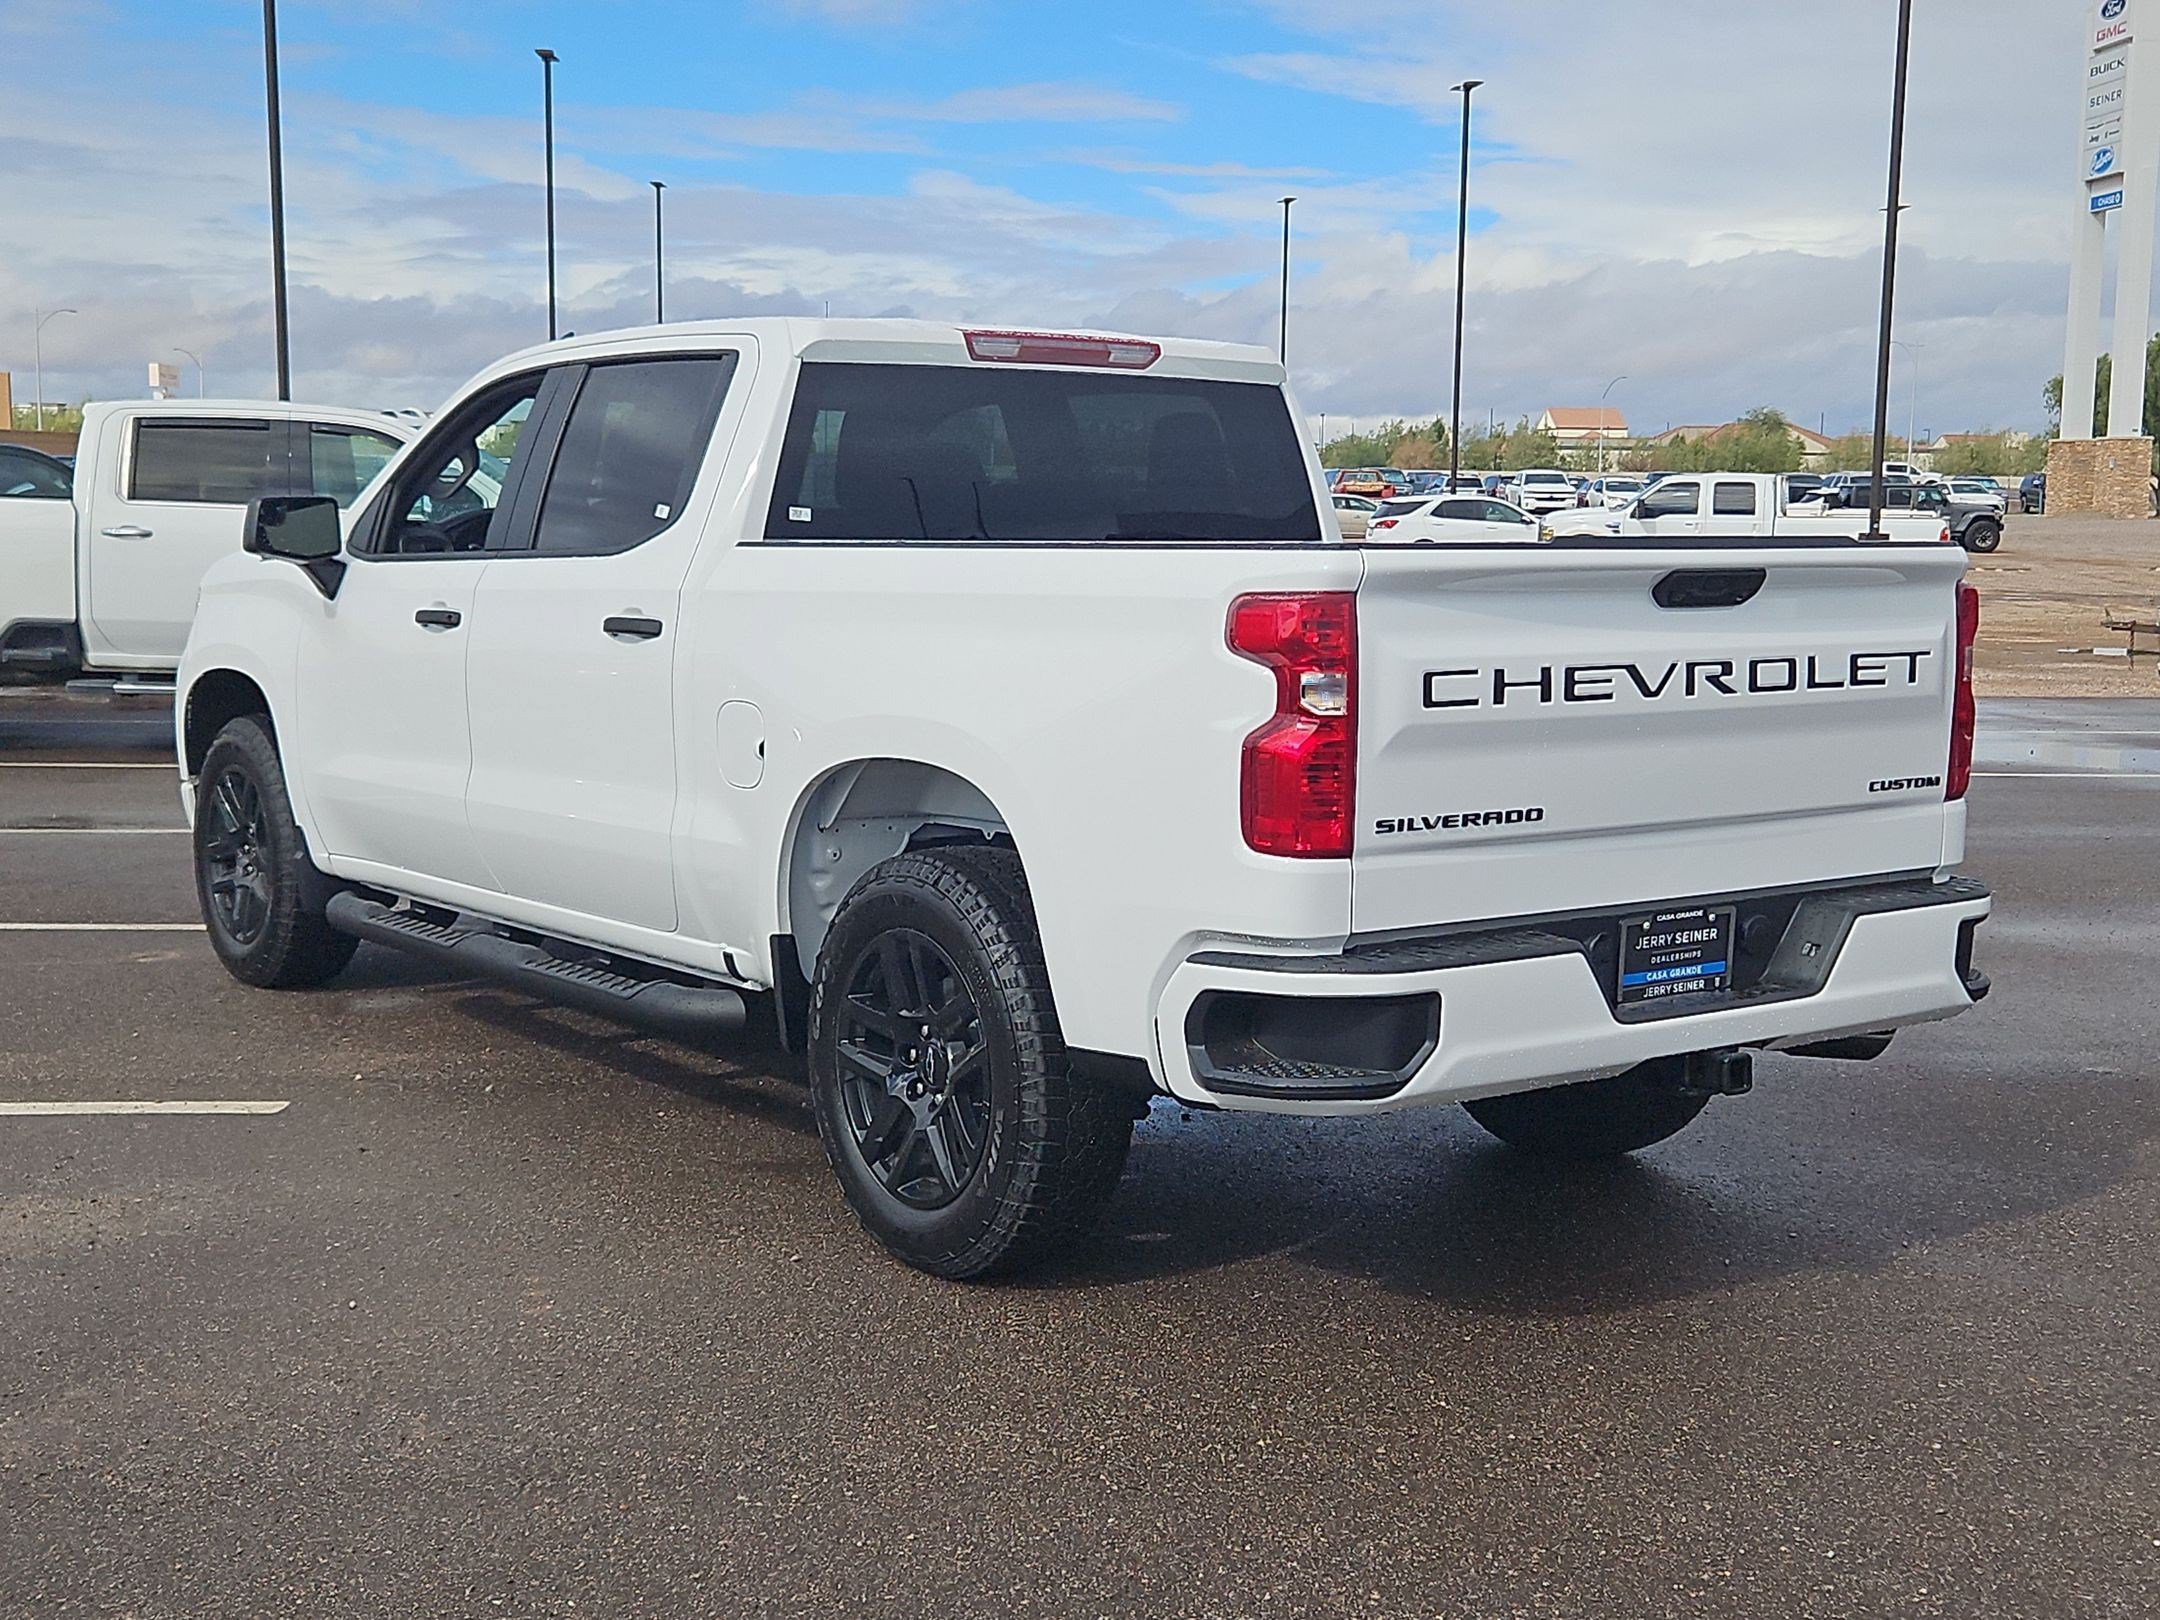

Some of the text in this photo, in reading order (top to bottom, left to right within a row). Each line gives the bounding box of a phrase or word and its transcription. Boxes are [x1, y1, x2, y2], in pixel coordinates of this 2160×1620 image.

[2096, 21, 2127, 42] GMC
[2090, 57, 2125, 77] BUICK
[2090, 89, 2122, 108] SEINER
[1422, 650, 1932, 708] CHEVROLET
[1869, 776, 1941, 792] CUSTOM
[1375, 808, 1544, 834] SILVERADO
[1656, 910, 1704, 921] CASA GRANDE
[1636, 928, 1718, 949] JERRY SEINER
[1651, 951, 1701, 963] DEALERSHIPS
[1646, 965, 1703, 981] CASA GRANDE
[1643, 980, 1705, 998] JERRY SEINER
